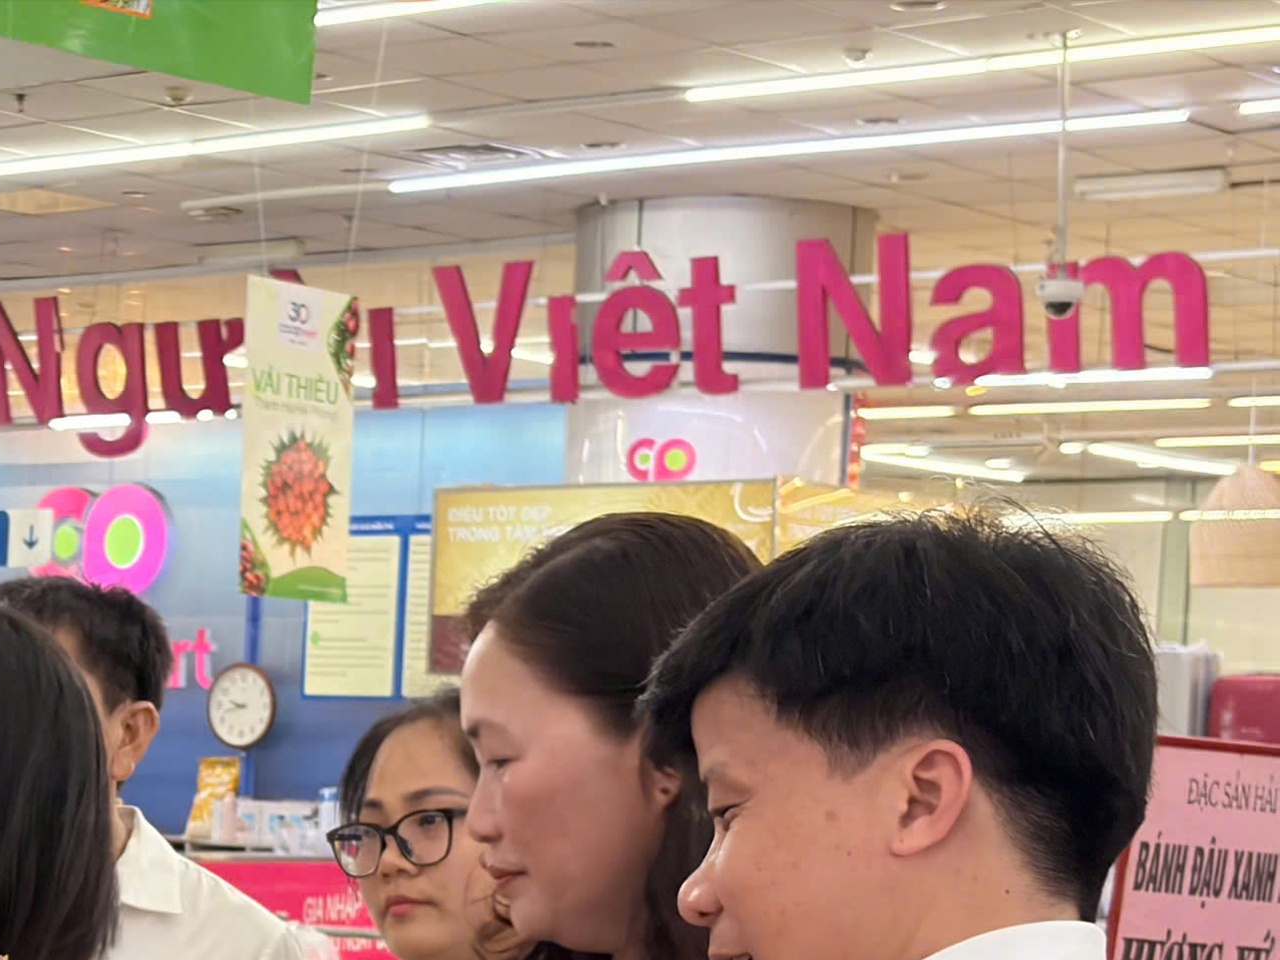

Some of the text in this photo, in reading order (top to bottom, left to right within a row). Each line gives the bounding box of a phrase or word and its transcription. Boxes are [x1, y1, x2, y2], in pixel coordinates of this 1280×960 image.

[796, 232, 1210, 391] Nam
[1186, 773, 1220, 813] ĐẶC
[1222, 769, 1251, 812] SẢN
[1132, 831, 1277, 909] BÁNH ĐẬU XANH
